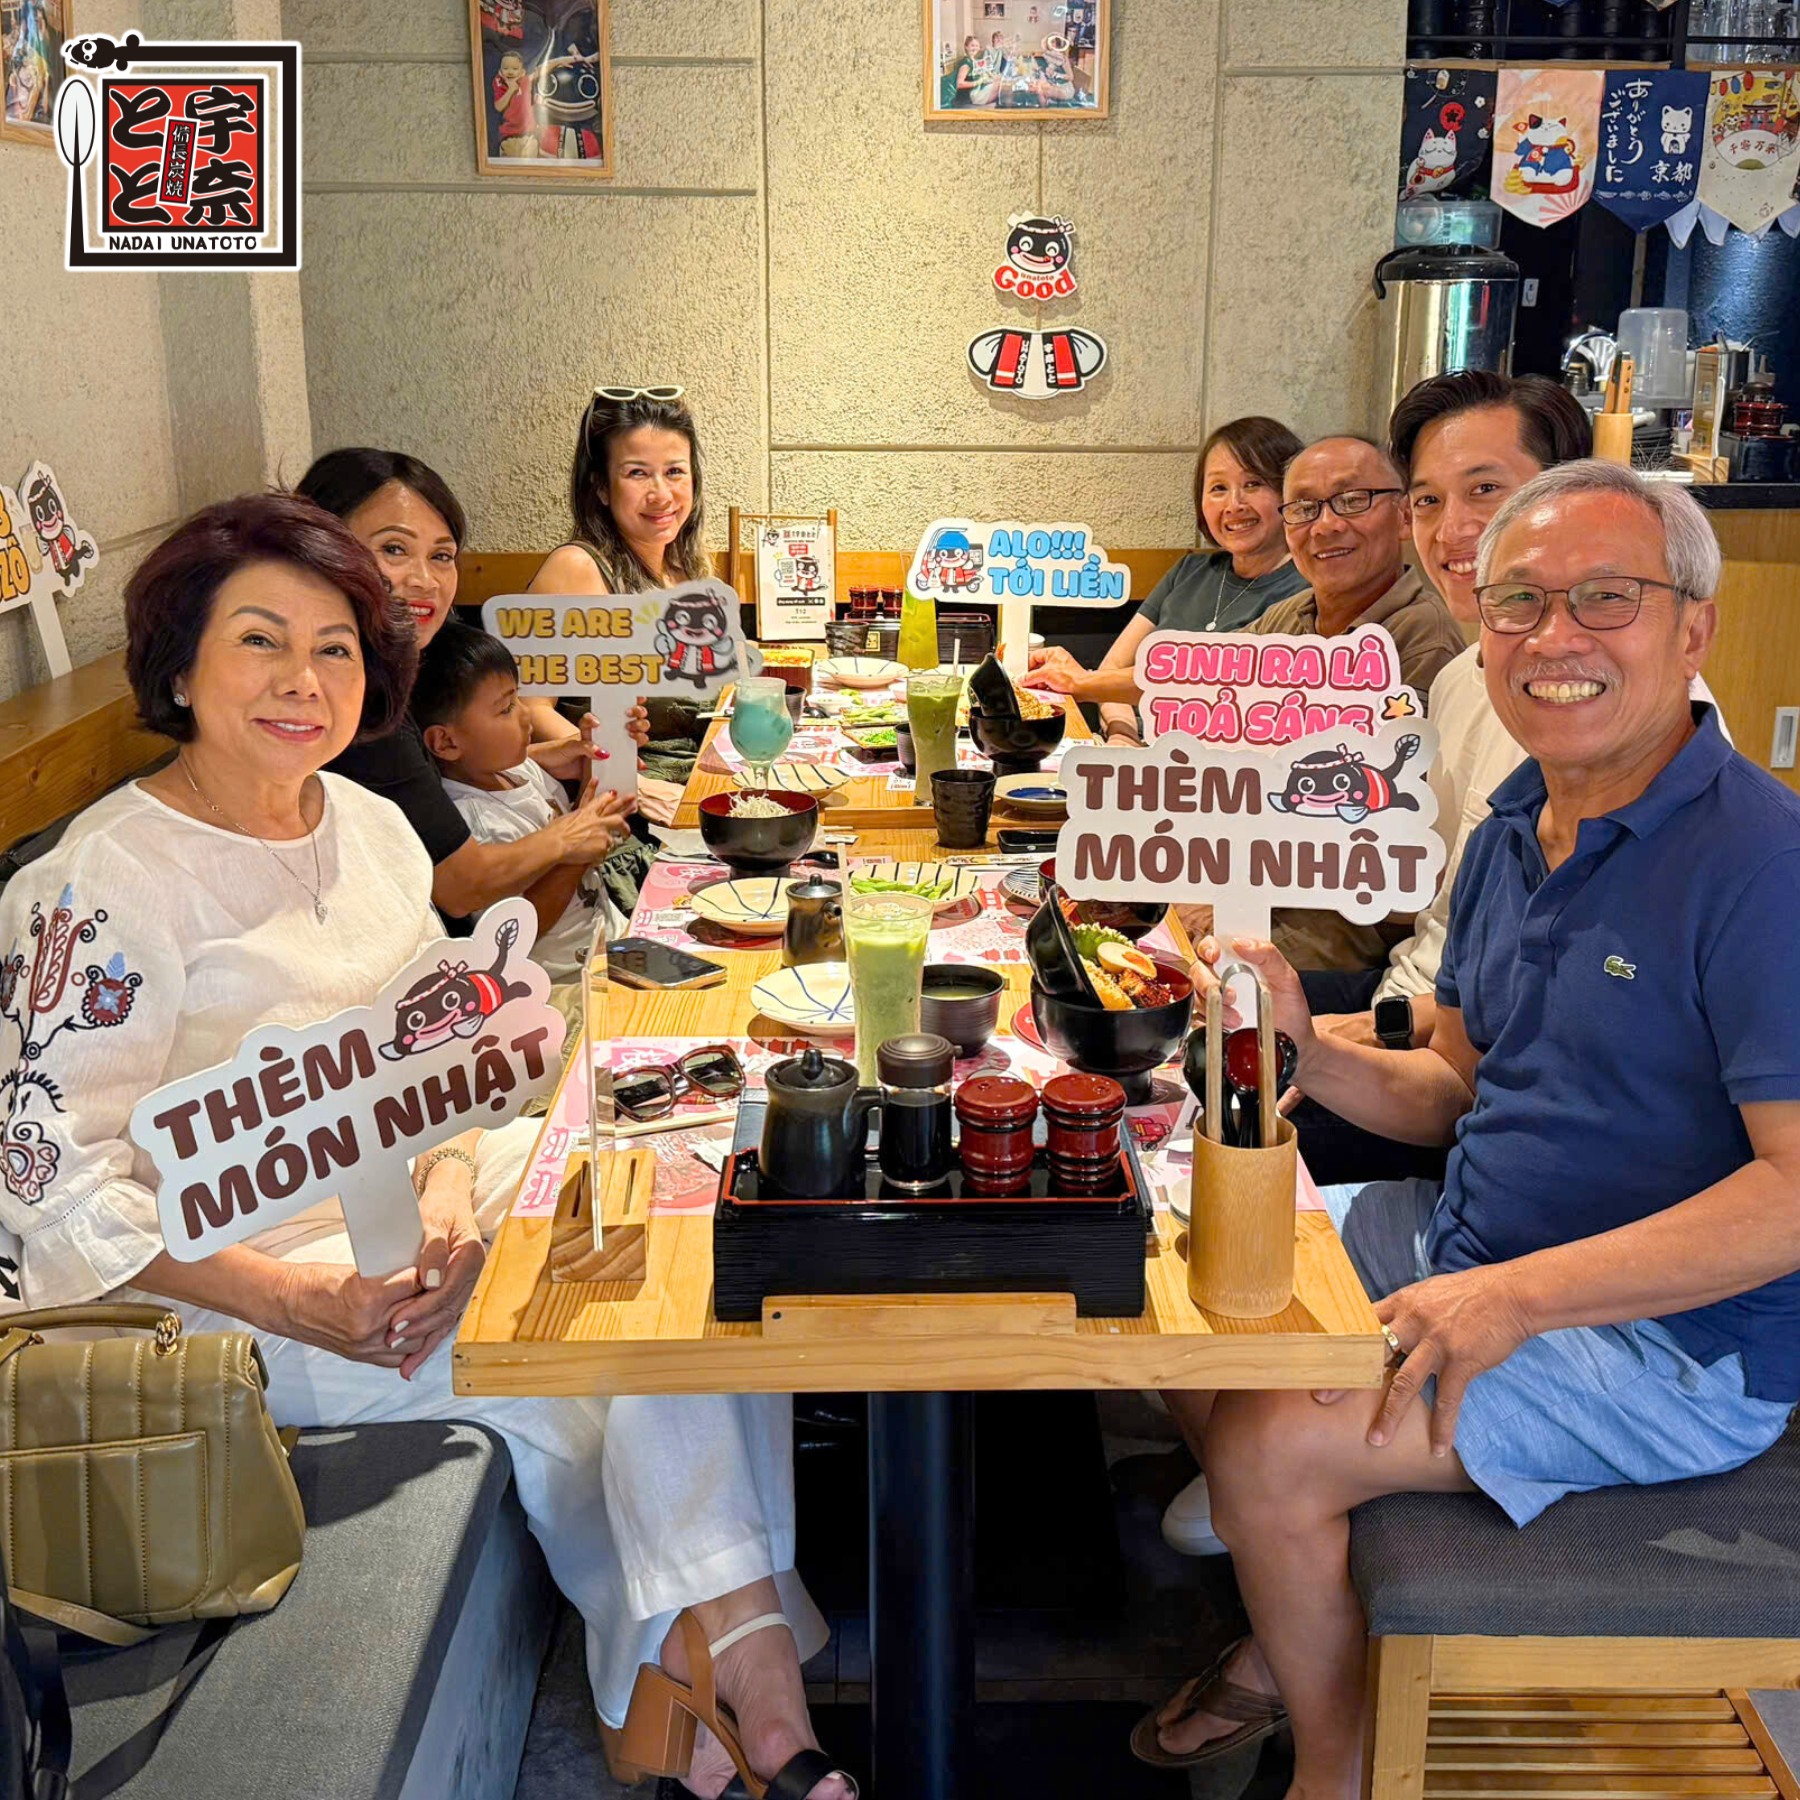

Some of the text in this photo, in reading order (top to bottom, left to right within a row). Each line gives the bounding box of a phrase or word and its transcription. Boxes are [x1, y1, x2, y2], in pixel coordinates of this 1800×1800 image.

[1602, 88, 1626, 183] ございました
[1621, 78, 1653, 164] ありがとう
[1649, 160, 1693, 186] 京都
[994, 264, 1076, 299] Good
[988, 529, 1086, 559] ALO!!!
[988, 554, 1124, 599] TỚI LIỀN
[496, 607, 632, 638] WE ARE
[575, 654, 666, 685] BEST
[1147, 634, 1389, 691] SINH RA LÀ
[1151, 687, 1241, 741] TOẢ
[1076, 748, 1262, 815] THÈM
[1074, 819, 1428, 905] MÓN NHẬT
[154, 1028, 377, 1161] THÈM
[179, 1026, 549, 1240] MÓN NHẬT
